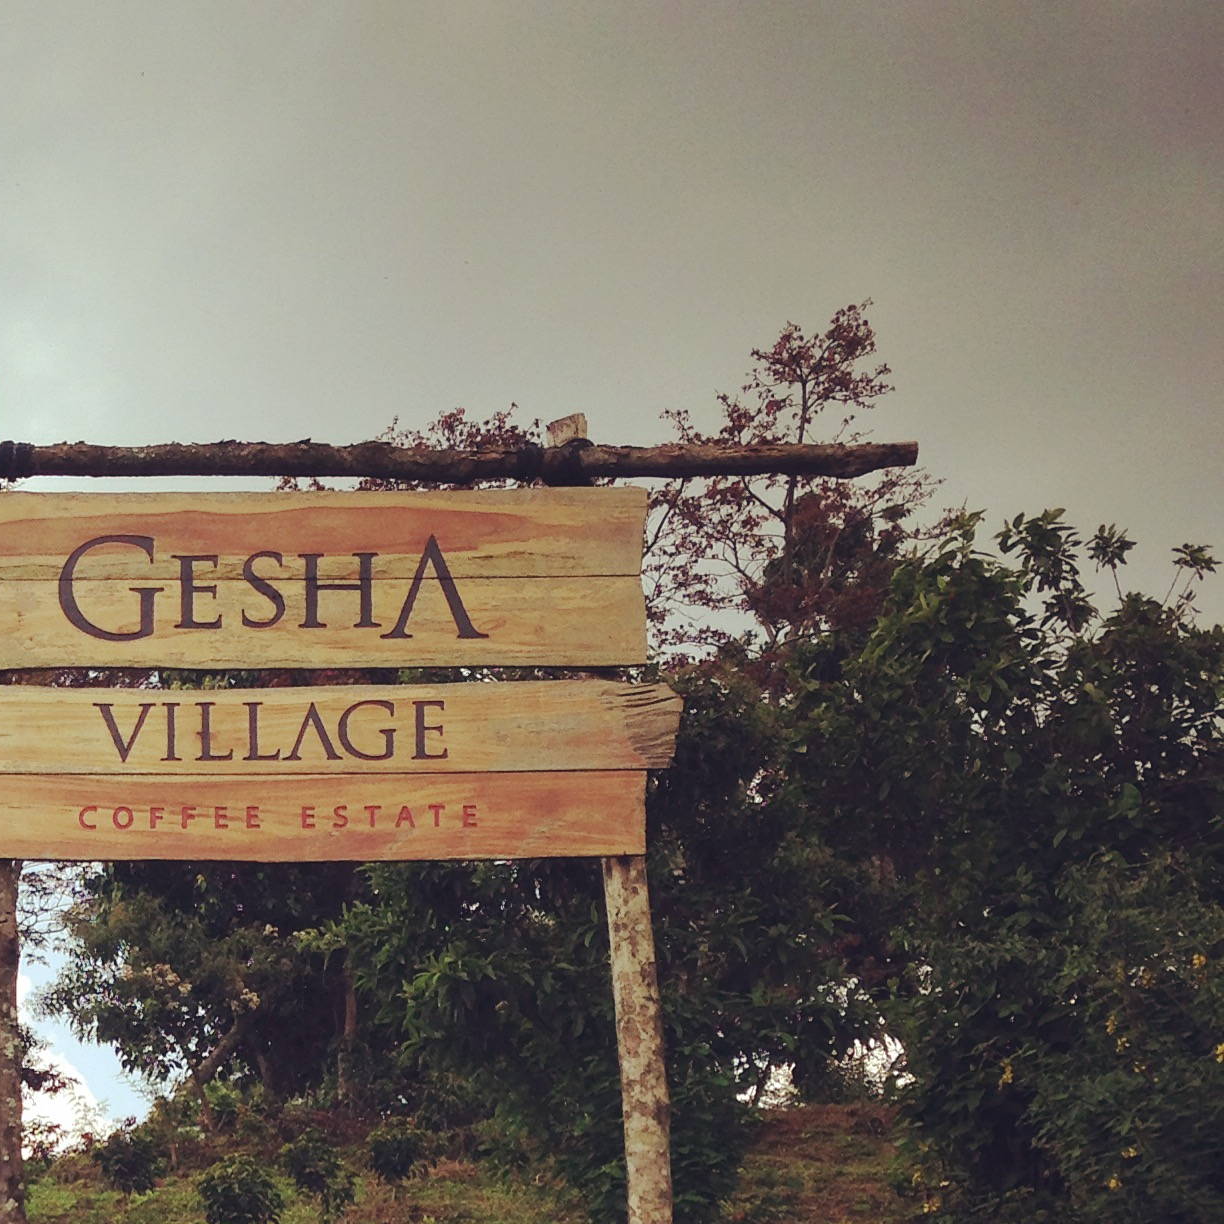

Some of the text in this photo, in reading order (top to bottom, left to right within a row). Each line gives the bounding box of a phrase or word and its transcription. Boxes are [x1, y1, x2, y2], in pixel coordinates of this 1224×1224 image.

[58, 534, 489, 642] GESHA
[92, 700, 449, 763] VILLAGE
[78, 803, 479, 831] COFFEE ESTATE
